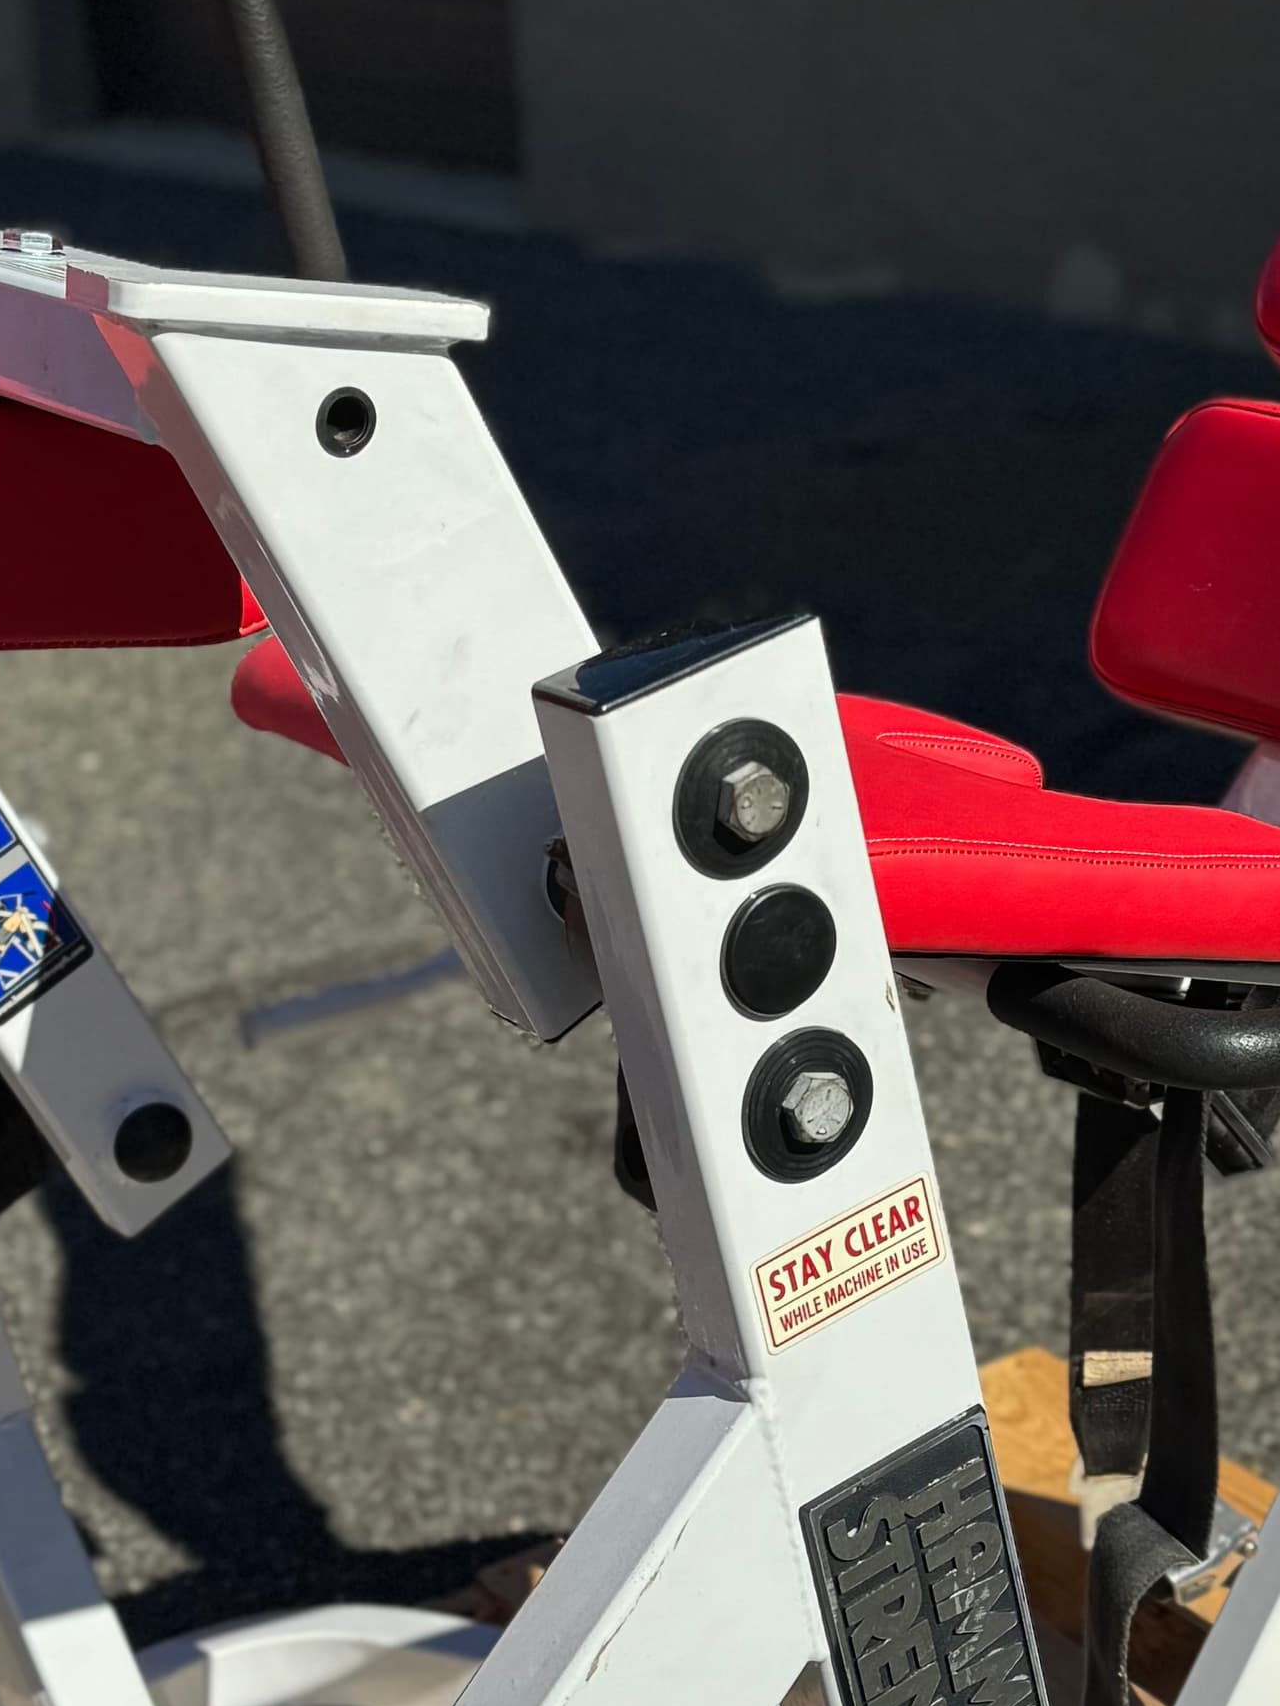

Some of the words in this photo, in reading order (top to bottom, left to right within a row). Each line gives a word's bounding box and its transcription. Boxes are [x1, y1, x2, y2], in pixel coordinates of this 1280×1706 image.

[769, 1239, 833, 1302] STAY
[844, 1195, 924, 1257] CLEAR
[780, 1296, 823, 1332] WHILE
[824, 1262, 883, 1308] MACHINE
[885, 1254, 900, 1274] IN
[902, 1238, 928, 1265] USE
